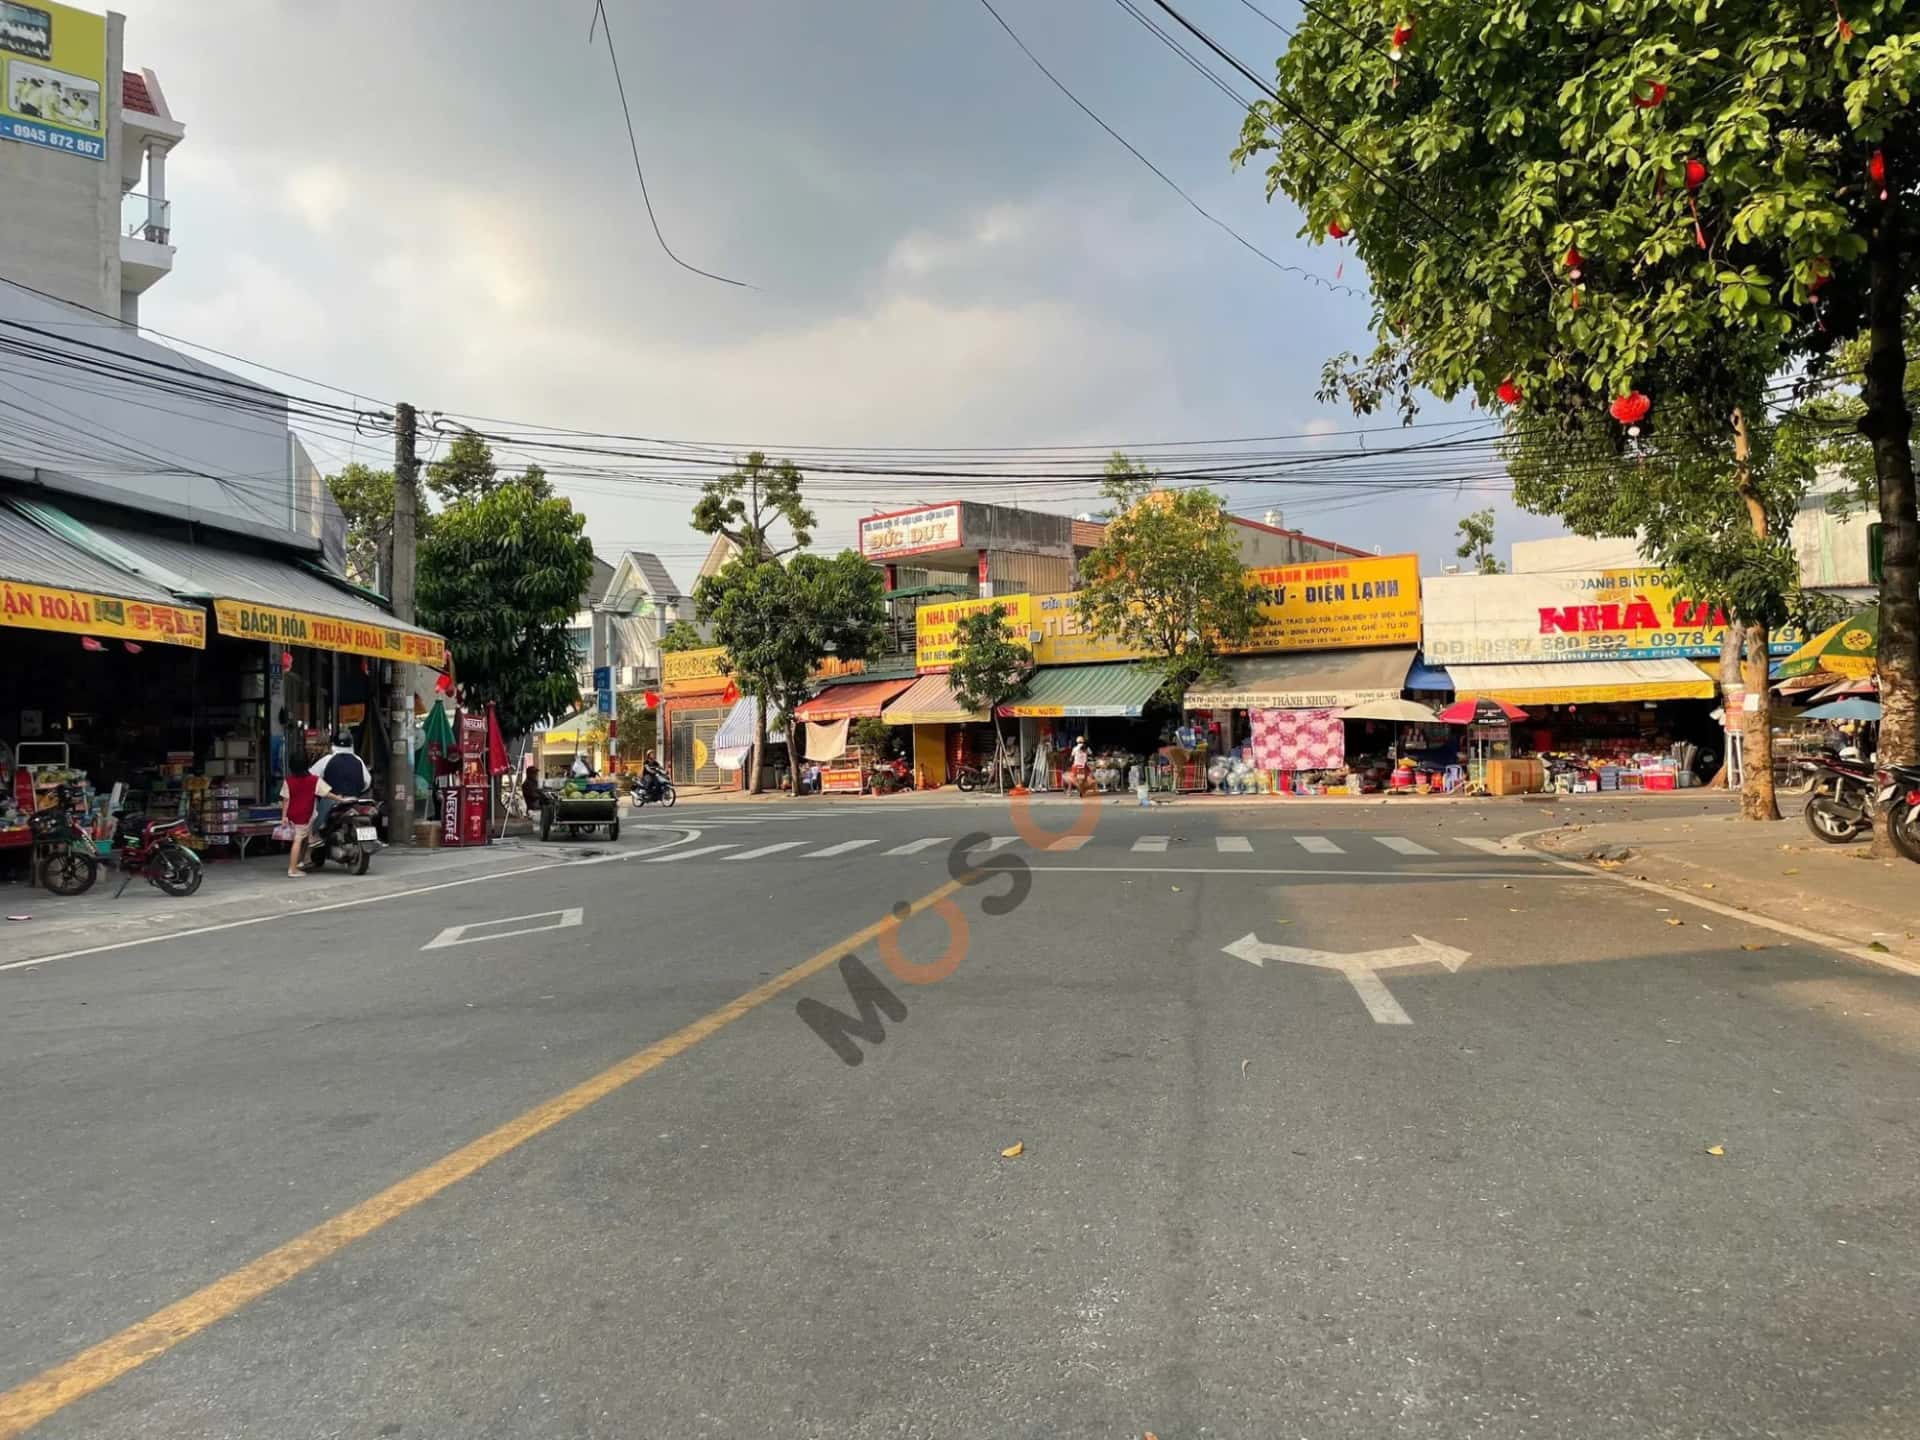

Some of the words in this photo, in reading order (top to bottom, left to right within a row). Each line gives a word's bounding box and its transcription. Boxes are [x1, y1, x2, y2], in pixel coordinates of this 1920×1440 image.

[911, 522, 948, 545] DUY
[1306, 581, 1345, 605] ĐIỆN
[1352, 580, 1399, 602] LẠNH
[39, 593, 91, 624] HOÀI
[1539, 595, 1661, 633] NHÀ
[240, 607, 278, 635] BÁCH
[281, 613, 307, 640] HÓA
[312, 621, 353, 646] THUẬN
[355, 628, 383, 651] HOÀI
[1651, 631, 1705, 647] 0978
[1306, 694, 1338, 706] NHUNG
[444, 790, 459, 841] NESCAFÉ
